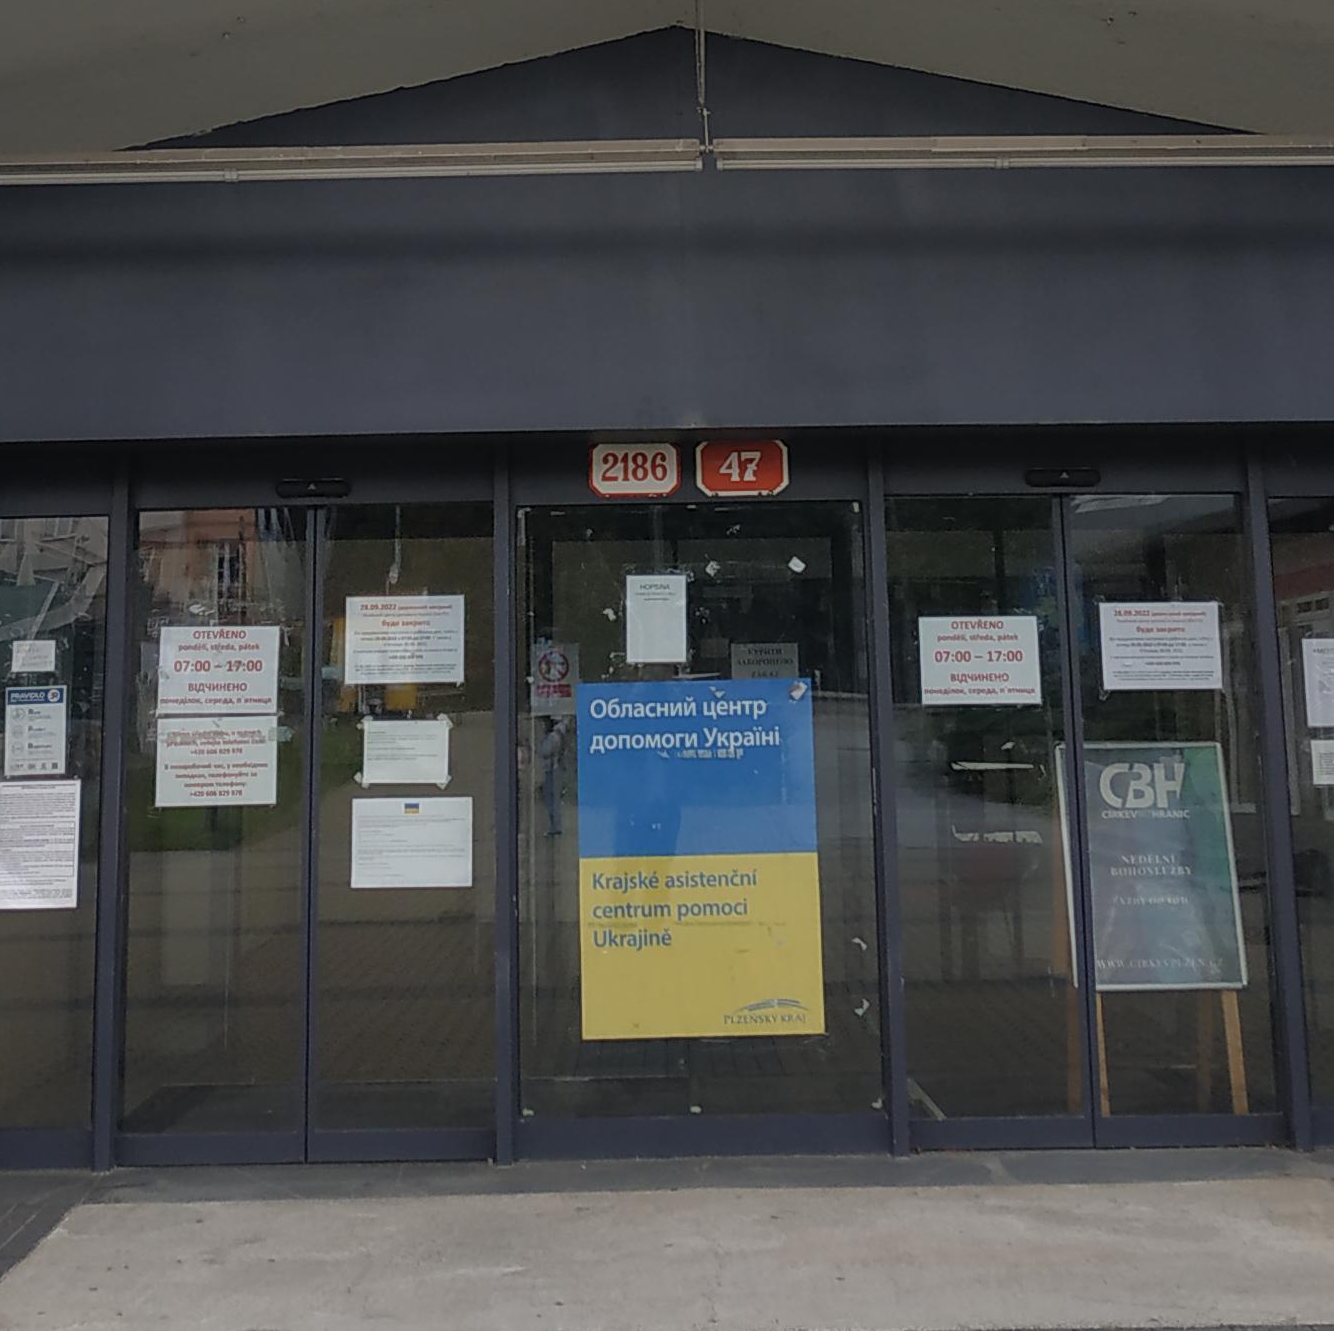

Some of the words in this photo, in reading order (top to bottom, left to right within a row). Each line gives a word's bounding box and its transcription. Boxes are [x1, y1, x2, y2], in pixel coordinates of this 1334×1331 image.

[601, 451, 667, 482] 2186
[719, 451, 761, 482] 47
[193, 628, 247, 640] OTEVŘENO
[951, 619, 1004, 630] OTEVŘENO
[174, 660, 211, 672] 07:00
[227, 660, 263, 672] 17:00
[934, 650, 971, 662] 07:00
[987, 650, 1023, 662] 17:00
[188, 682, 248, 693] ВІДЧИНЕНО
[950, 673, 1009, 683] ВІДЧИНЕНО
[589, 697, 696, 719] Обласний
[703, 699, 767, 720] центр
[589, 731, 698, 754] допомоги
[703, 726, 780, 753] Україні
[1099, 762, 1185, 809] CBH
[592, 870, 659, 894] Krajské
[664, 868, 757, 888] asistenční
[593, 901, 671, 919] centrum
[677, 898, 748, 921] pomoci
[593, 927, 672, 951] Ukrajině
